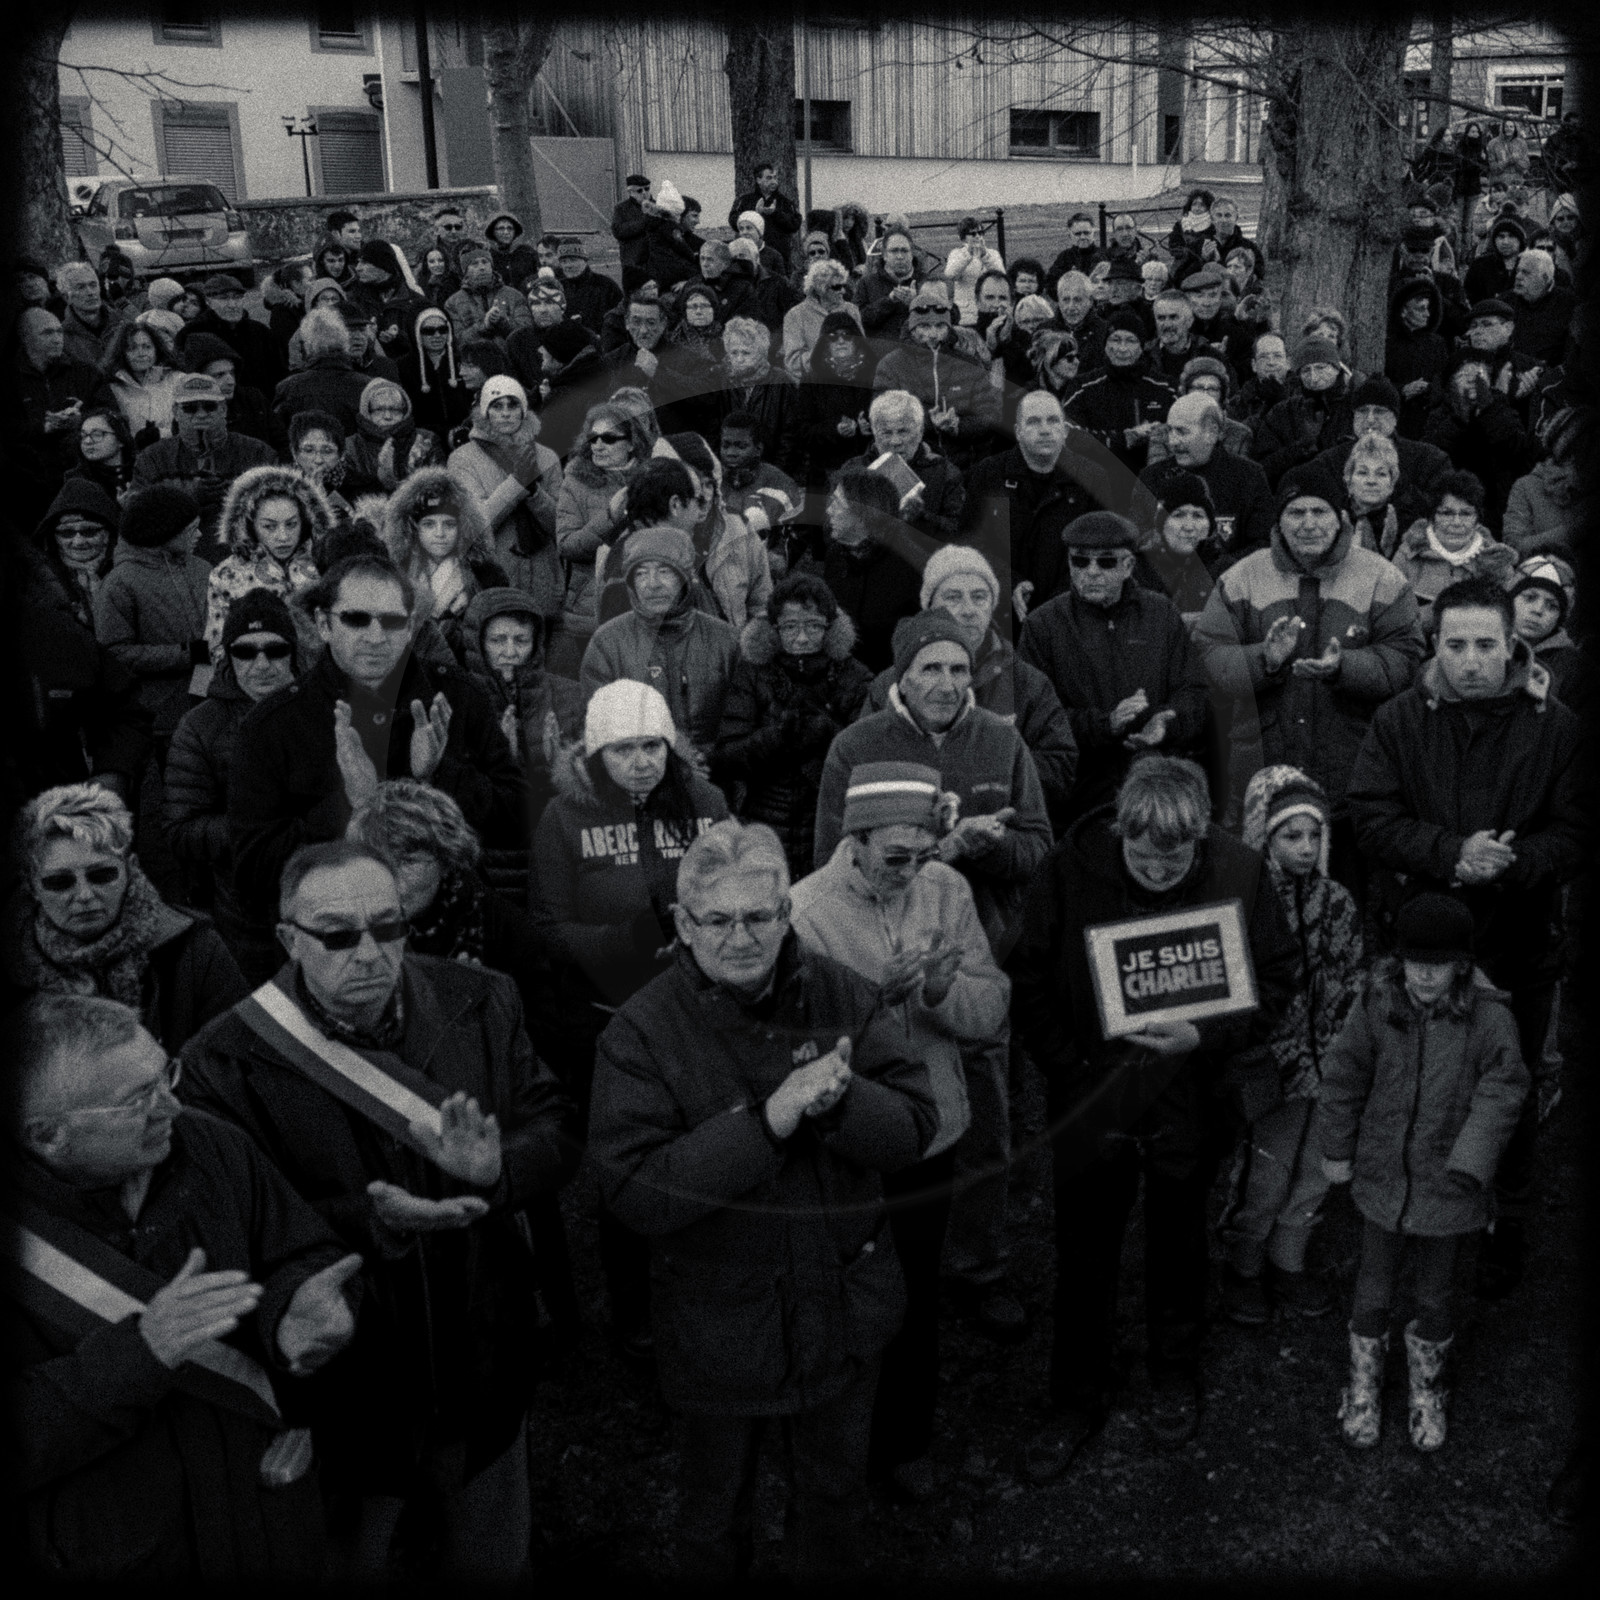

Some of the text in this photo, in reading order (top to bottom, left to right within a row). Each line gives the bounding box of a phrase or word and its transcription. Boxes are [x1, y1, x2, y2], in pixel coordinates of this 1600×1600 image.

[1121, 938, 1220, 972] JE SUIS
[1123, 958, 1226, 999] CHARLIE
